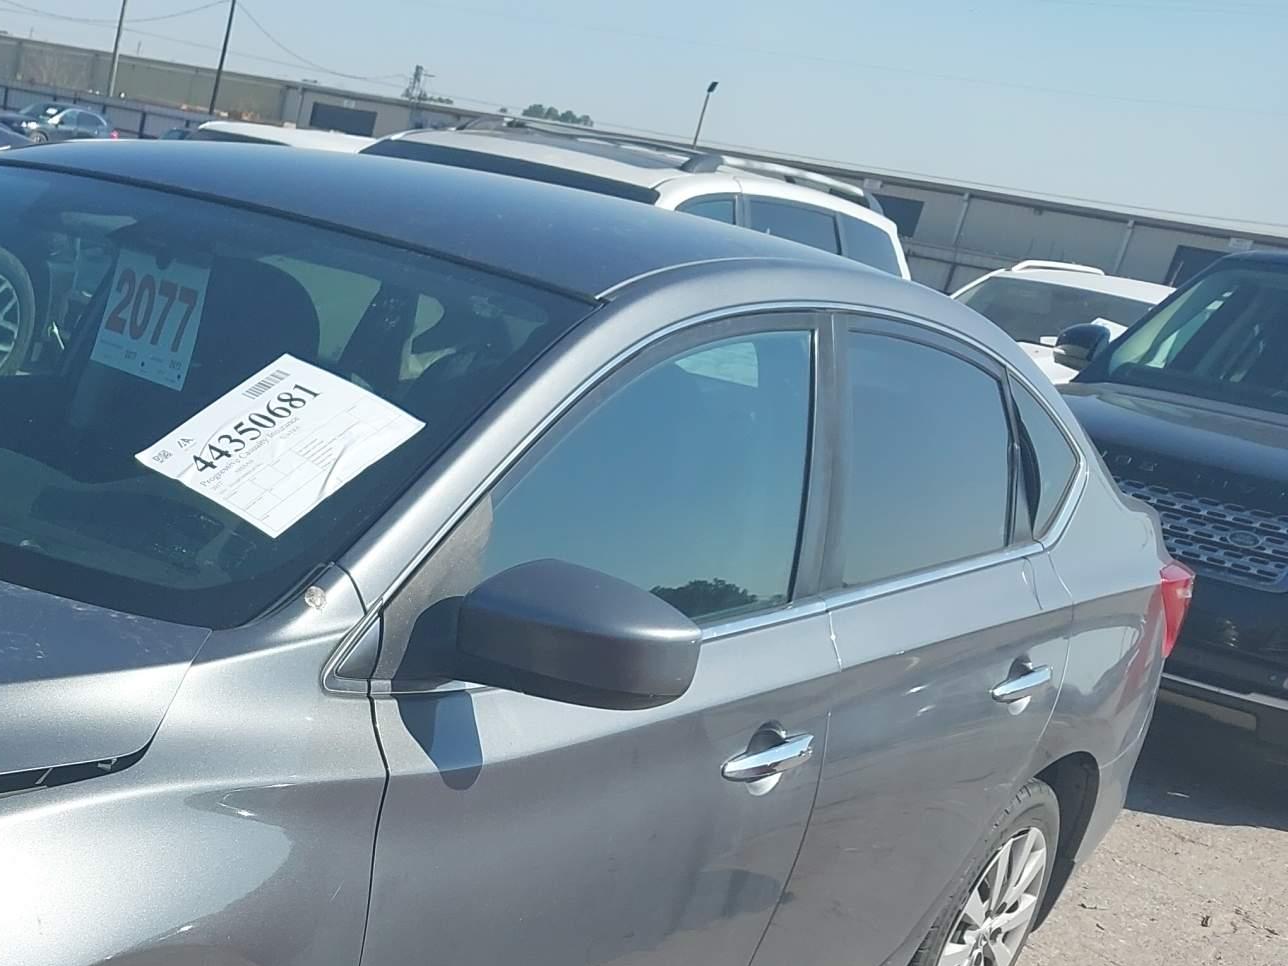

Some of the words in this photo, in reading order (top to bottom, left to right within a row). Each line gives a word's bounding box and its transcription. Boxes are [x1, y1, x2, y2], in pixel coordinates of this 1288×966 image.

[106, 269, 198, 352] 2077
[192, 383, 321, 473] 44350681
[238, 437, 270, 461] Casualty
